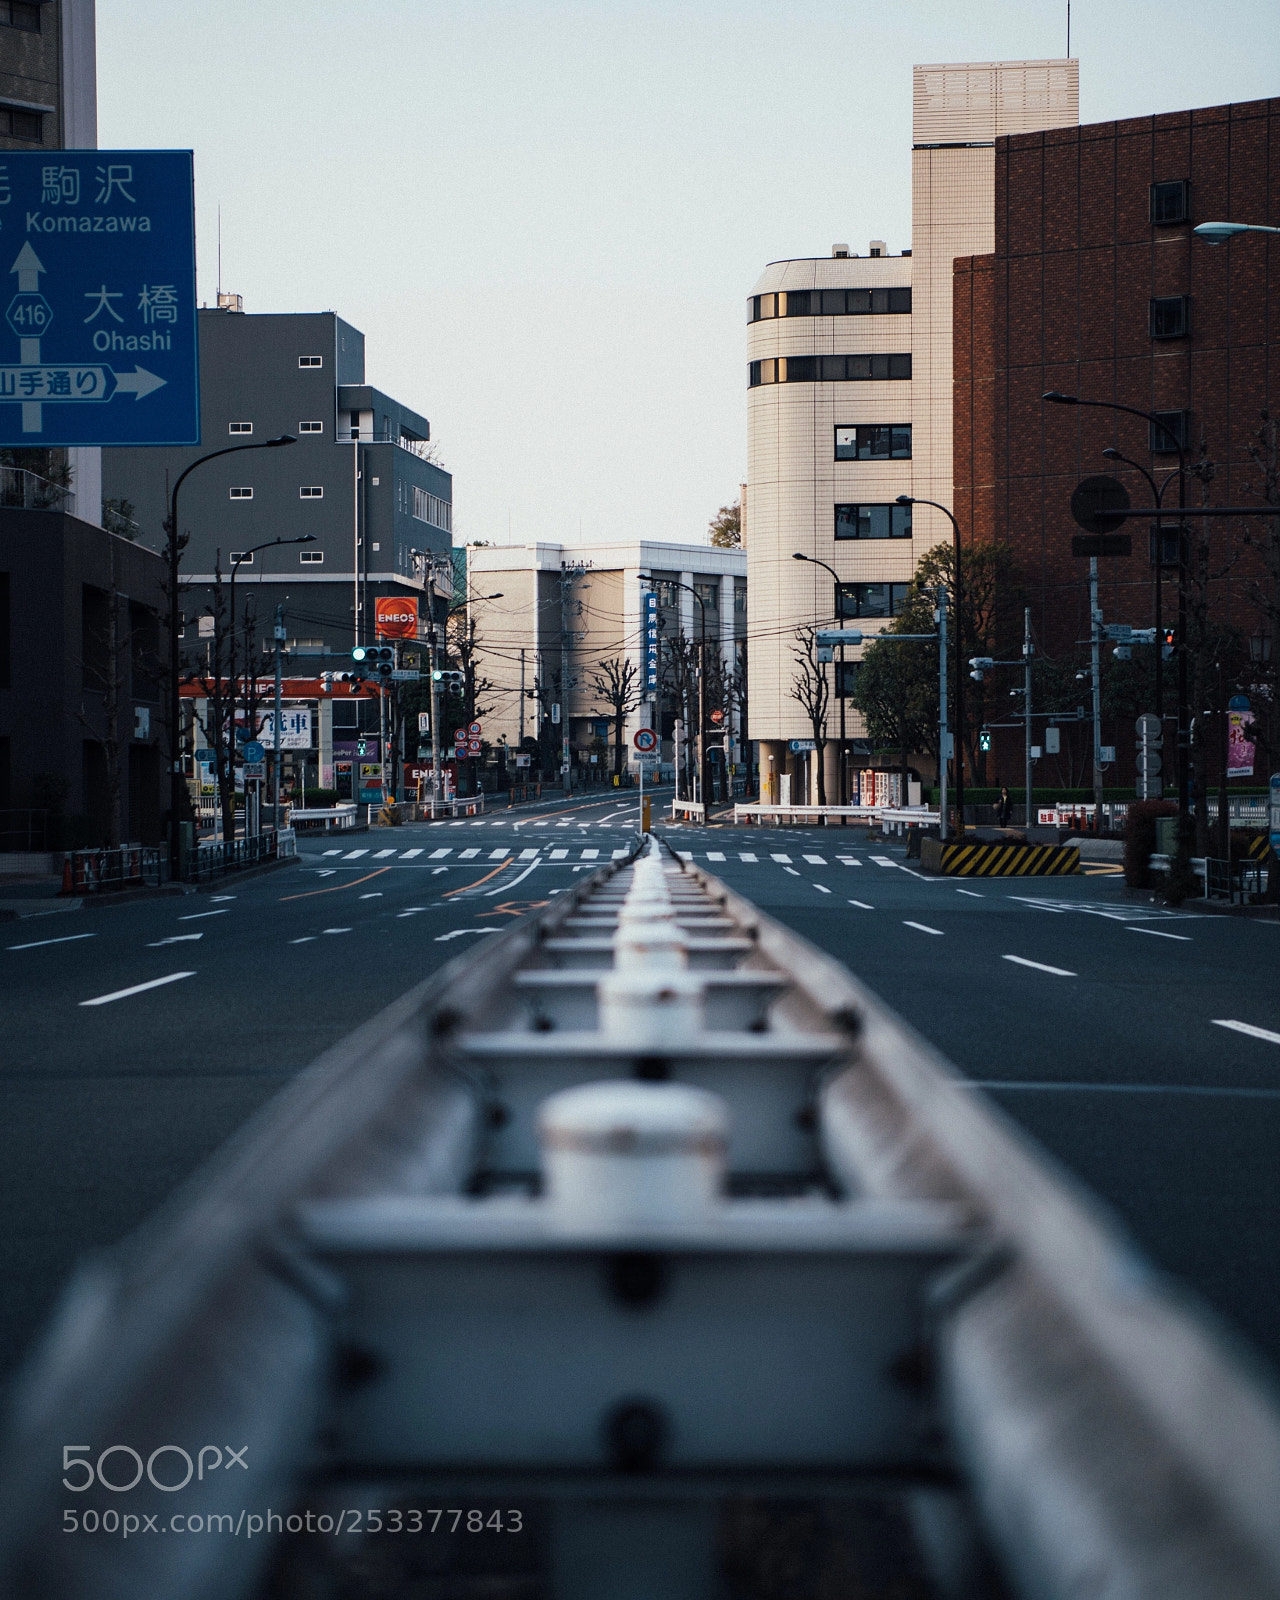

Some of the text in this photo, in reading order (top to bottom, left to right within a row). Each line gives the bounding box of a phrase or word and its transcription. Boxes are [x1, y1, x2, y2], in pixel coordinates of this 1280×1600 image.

[41, 165, 136, 205] 駒沢
[26, 211, 151, 232] Komazawa
[83, 284, 178, 324] 大橋
[13, 305, 46, 325] 416
[93, 330, 171, 351] Ohashi
[378, 613, 415, 622] ENEOS
